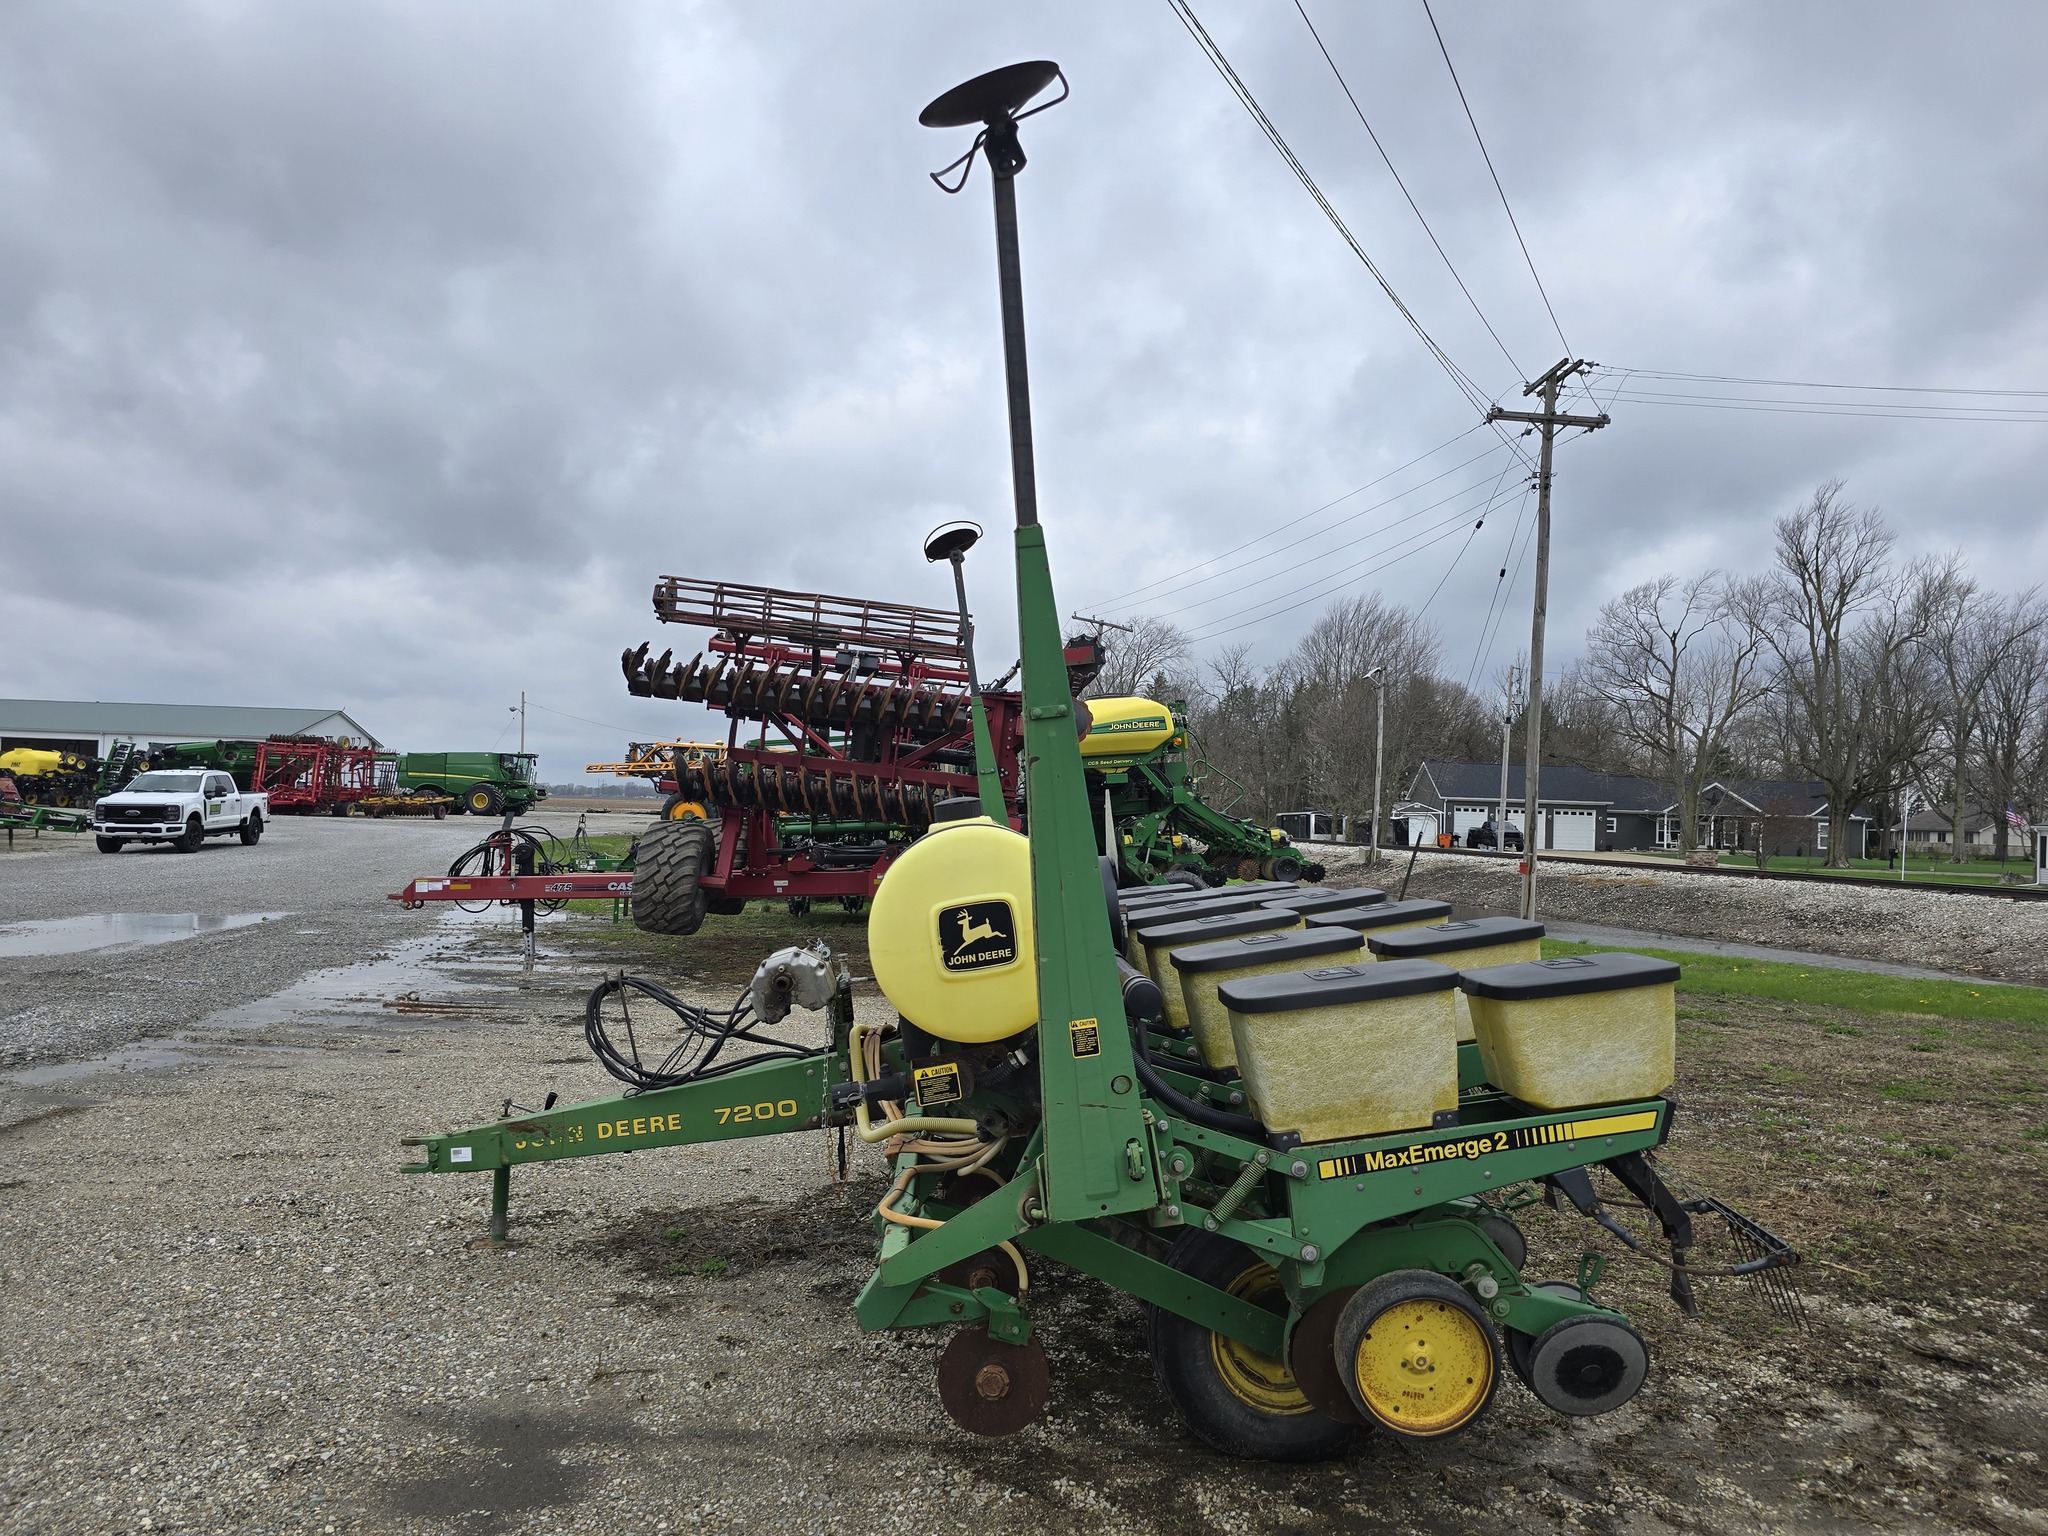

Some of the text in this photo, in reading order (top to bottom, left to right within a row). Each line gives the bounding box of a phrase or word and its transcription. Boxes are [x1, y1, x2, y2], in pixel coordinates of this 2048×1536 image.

[1109, 720, 1160, 731] JOHN DEERE
[550, 881, 633, 893] 475 CAS
[948, 948, 1012, 966] JOHN DEERE
[930, 1065, 954, 1076] CAUTION
[597, 1113, 682, 1140] DEERE
[713, 1098, 799, 1126] 7200
[1364, 1131, 1509, 1172] MaxEmerge 2
